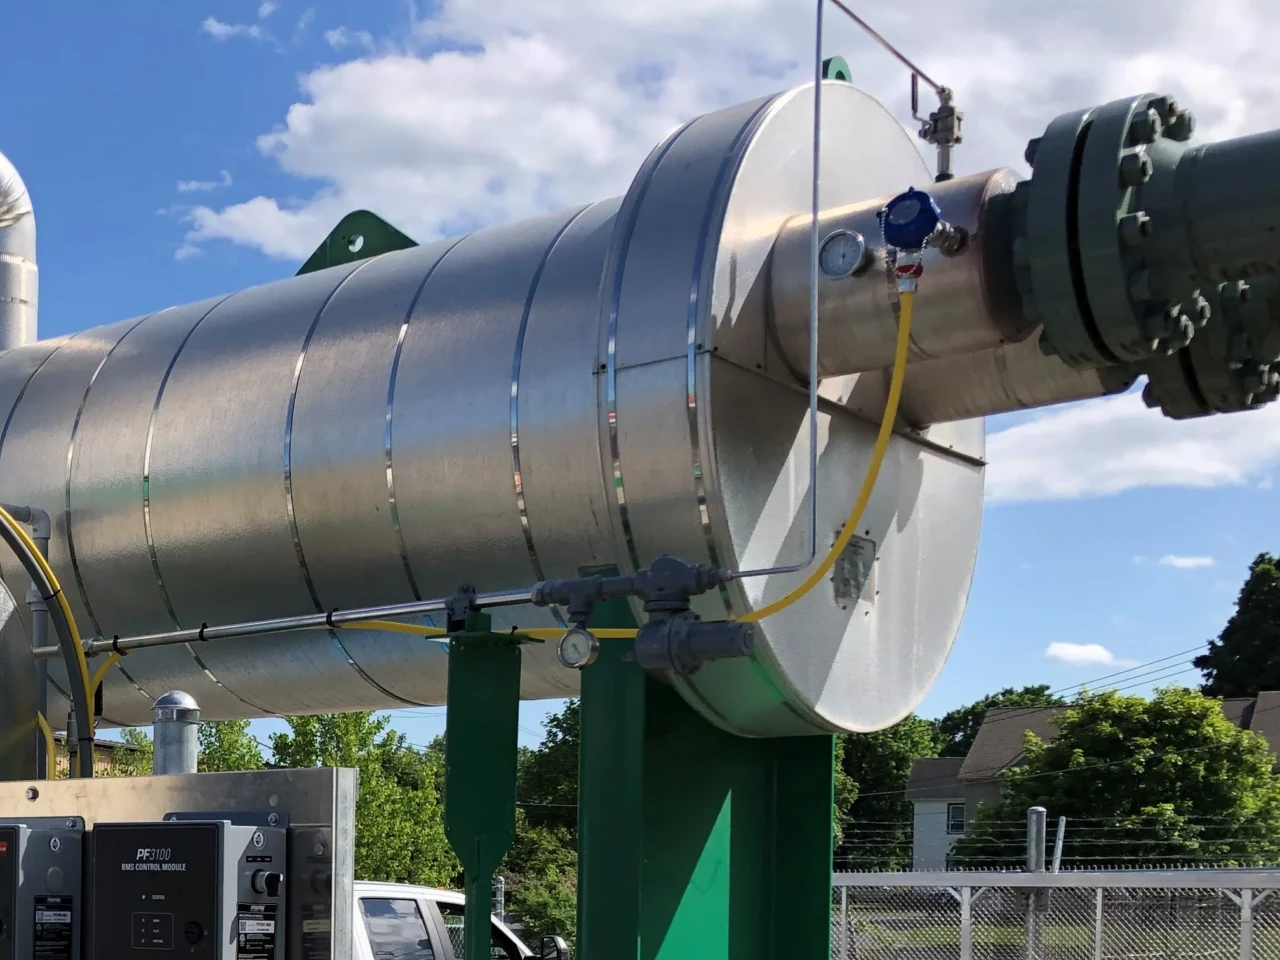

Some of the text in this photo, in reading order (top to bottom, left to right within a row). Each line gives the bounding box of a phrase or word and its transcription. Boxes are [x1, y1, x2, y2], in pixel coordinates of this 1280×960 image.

[136, 848, 171, 861] PF3100
[121, 863, 187, 871] BMS CONTROL MODULE
